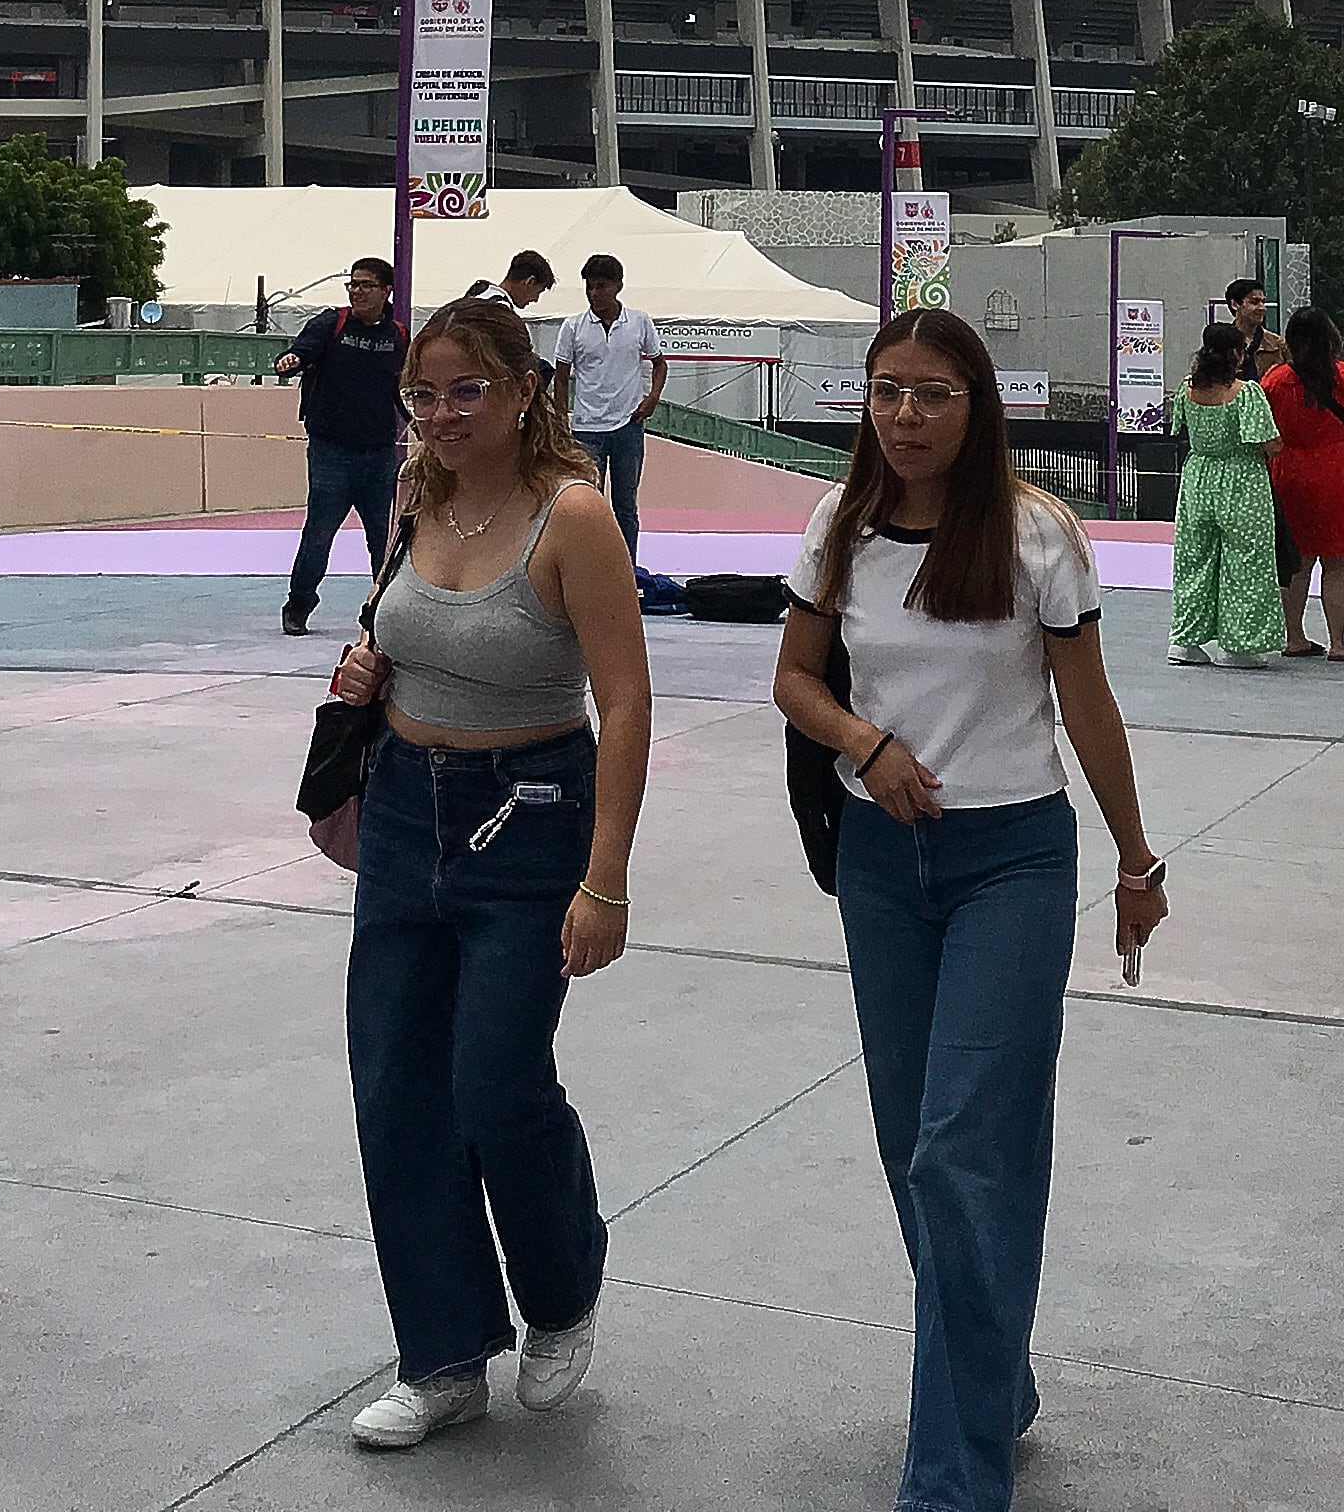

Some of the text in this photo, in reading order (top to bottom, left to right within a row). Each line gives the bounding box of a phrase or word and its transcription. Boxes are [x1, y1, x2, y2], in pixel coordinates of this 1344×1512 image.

[414, 119, 483, 132] LA PELOTA
[414, 134, 482, 143] VUELVE A CASA
[897, 147, 906, 161] 7
[656, 327, 752, 338] TACIONAMIENTO
[671, 341, 716, 350] OFICIAL
